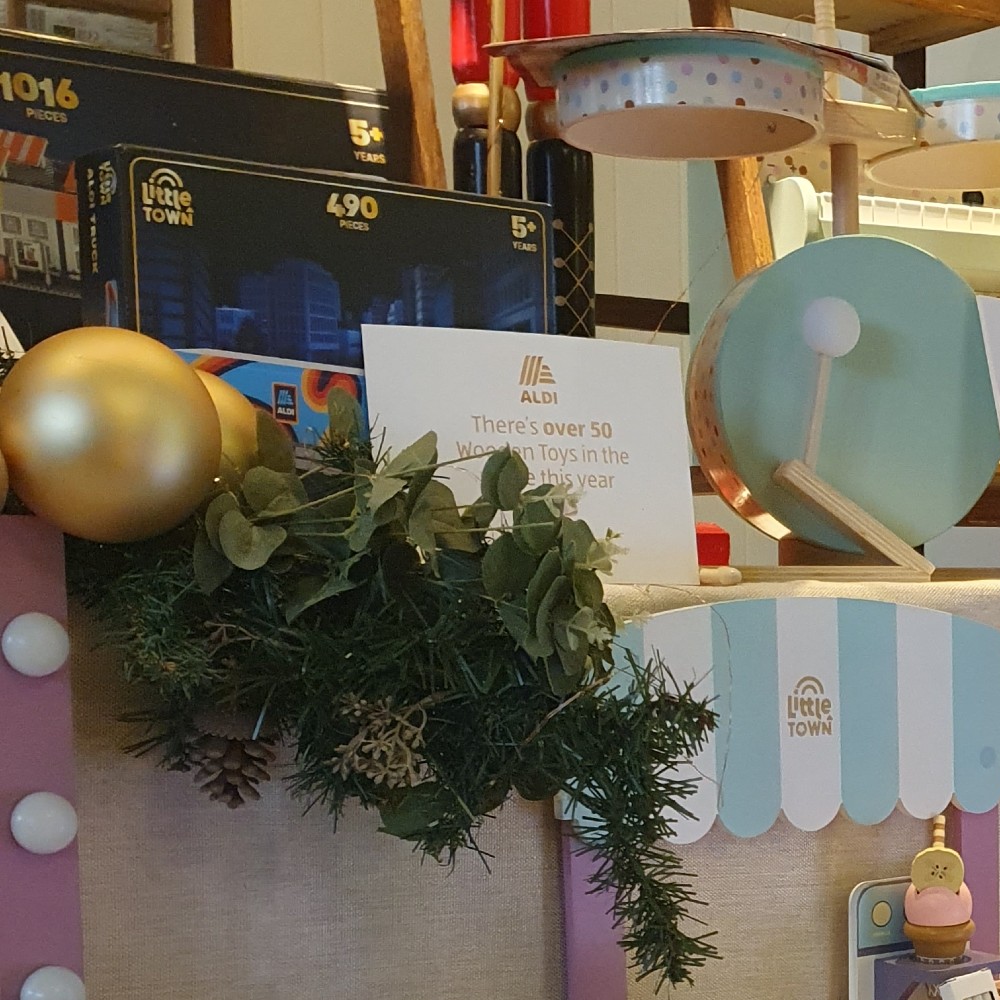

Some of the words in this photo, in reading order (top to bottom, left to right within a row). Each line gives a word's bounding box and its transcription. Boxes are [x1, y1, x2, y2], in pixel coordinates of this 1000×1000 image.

[0, 71, 80, 110] 1016
[26, 107, 68, 123] PIECES
[348, 118, 384, 147] 5+
[352, 150, 387, 165] YEARS
[141, 178, 192, 210] Little
[326, 192, 379, 220] 490
[142, 207, 194, 227] TOWN
[338, 219, 370, 232] PIECES
[510, 215, 537, 239] 5+
[89, 213, 99, 274] TRUCK
[512, 241, 537, 253] YEARS
[520, 390, 558, 405] ALDI
[276, 407, 295, 416] ALDI
[471, 415, 539, 437] There's
[543, 421, 586, 438] over
[590, 421, 613, 439] 50
[539, 444, 578, 466] Toys
[582, 445, 597, 463] in
[601, 446, 630, 465] the
[540, 470, 574, 487] this
[577, 472, 615, 490] year
[787, 688, 832, 720] Little
[787, 719, 833, 738] TOWN
